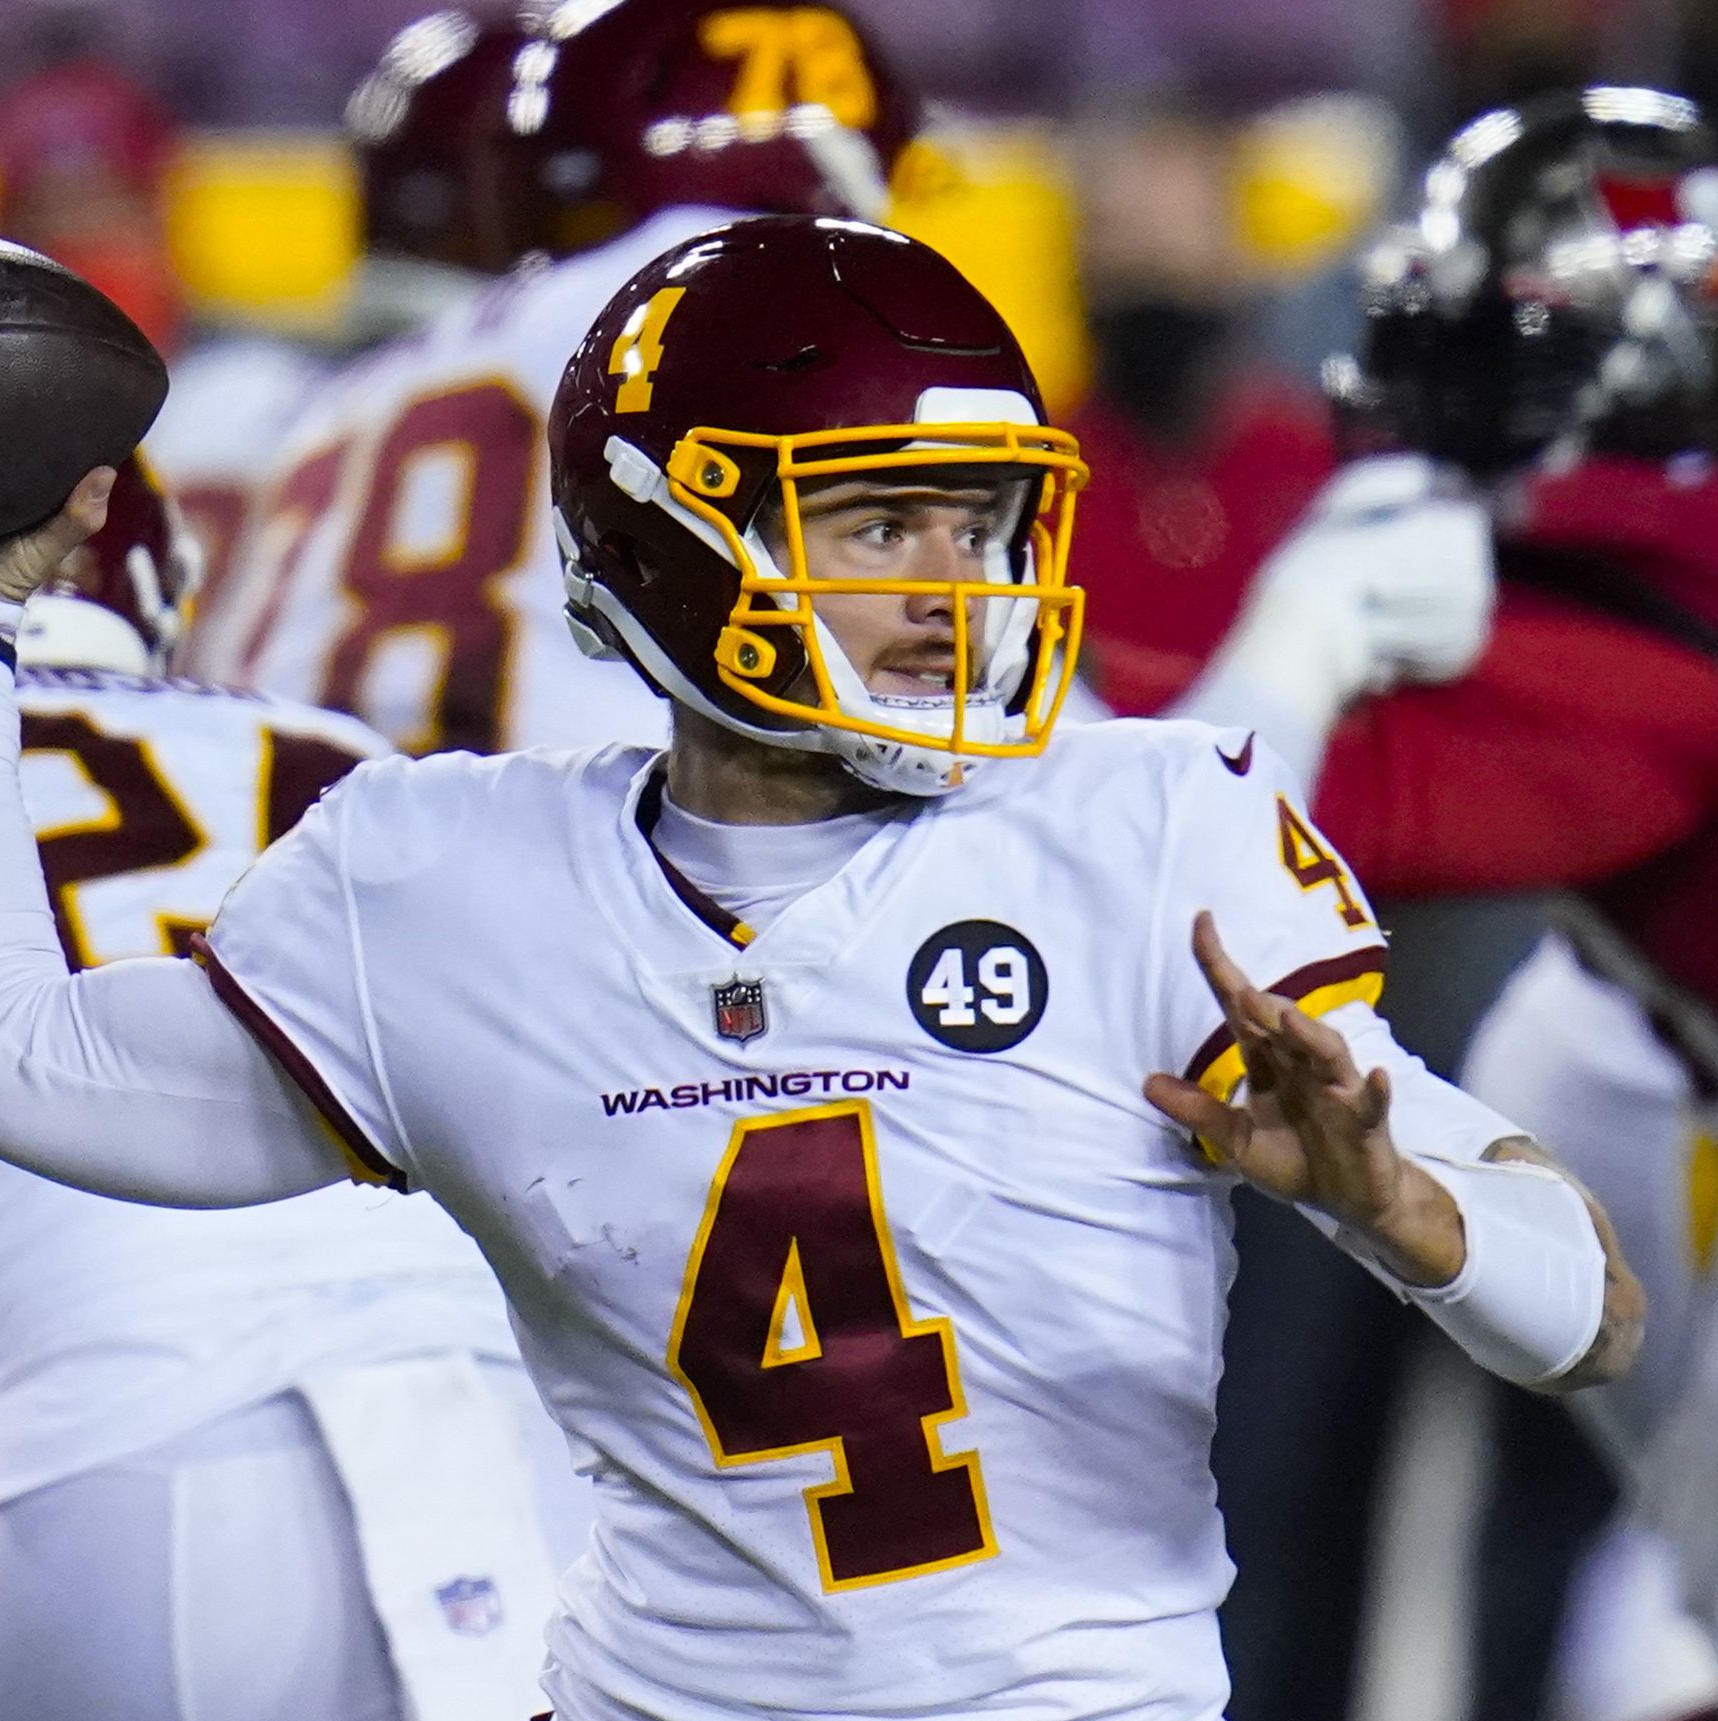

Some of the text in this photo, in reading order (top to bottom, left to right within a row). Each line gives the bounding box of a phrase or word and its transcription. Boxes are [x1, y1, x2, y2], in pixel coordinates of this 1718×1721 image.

[608, 286, 686, 413] 4
[1275, 790, 1375, 932] 4
[922, 946, 1030, 1026] 49
[600, 1070, 910, 1117] WASHINGTON
[665, 1096, 1003, 1595] 4
